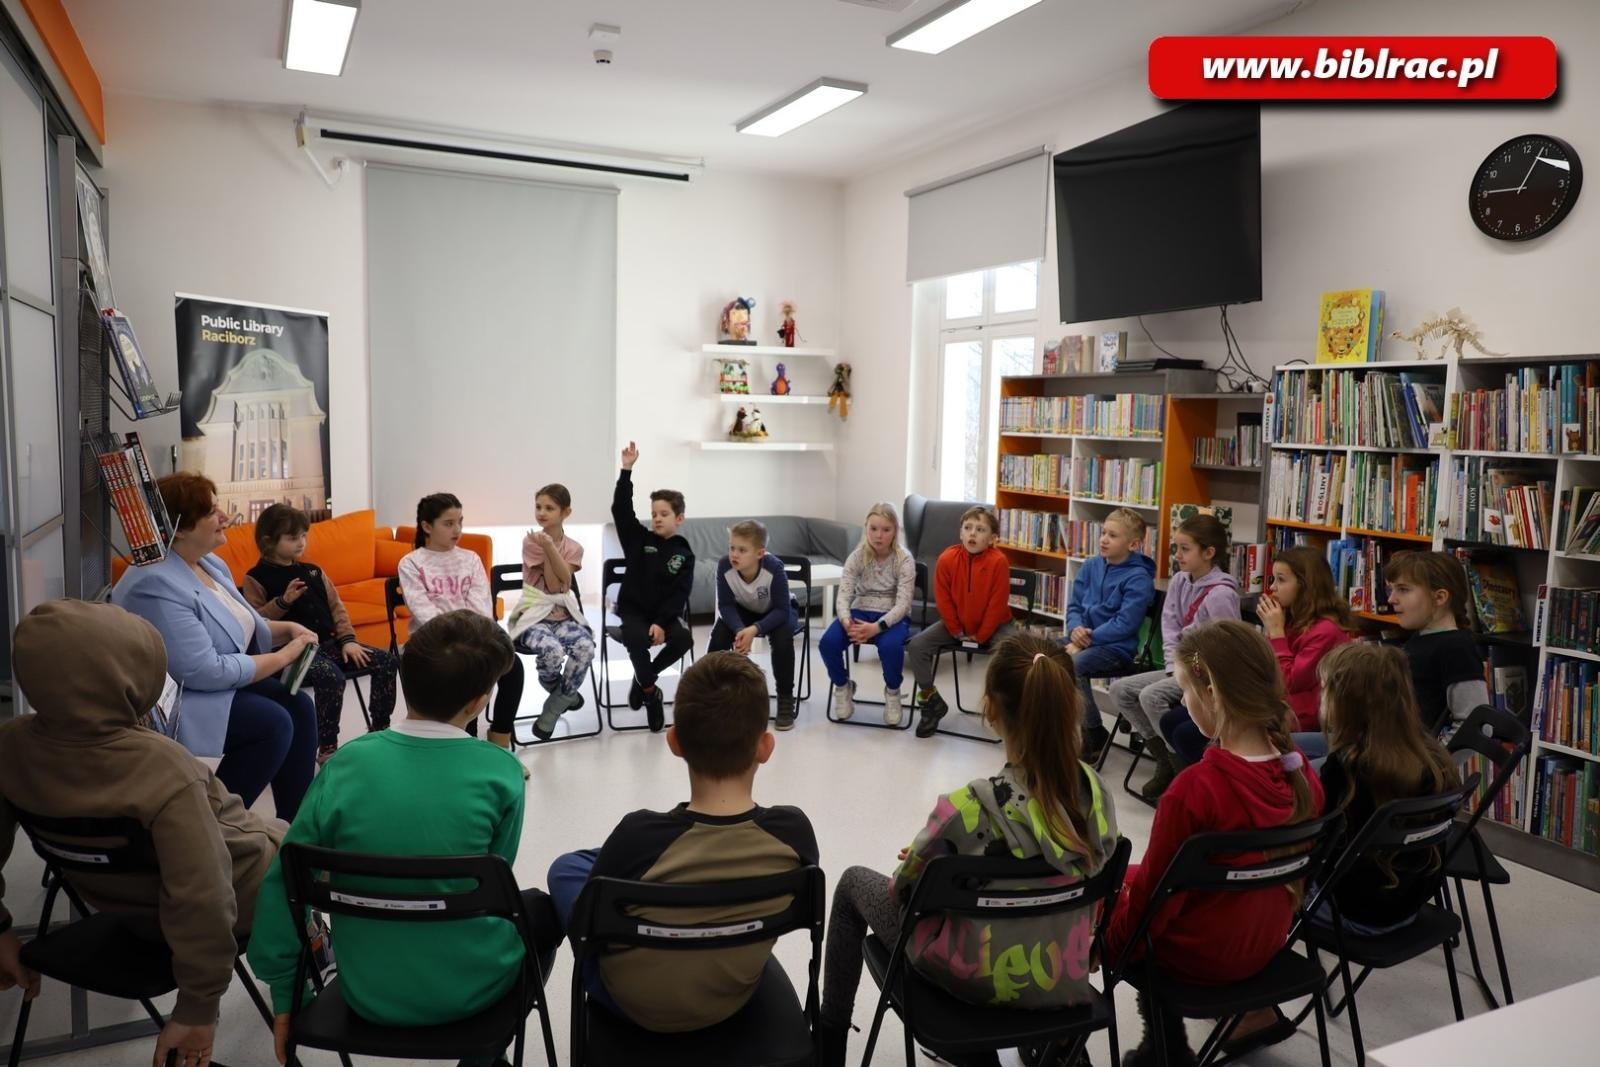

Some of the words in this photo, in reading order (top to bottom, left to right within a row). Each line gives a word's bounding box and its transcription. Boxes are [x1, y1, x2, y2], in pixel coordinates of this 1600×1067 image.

[1523, 145, 1532, 154] 12
[1504, 155, 1512, 163] 11
[1490, 170, 1498, 178] 10
[1559, 180, 1565, 188] 3
[1482, 191, 1488, 199] 9
[1552, 198, 1557, 206] 4
[1485, 207, 1491, 215] 8
[1535, 214, 1541, 223] 5
[1497, 220, 1503, 228] 7
[1514, 223, 1521, 232] 6
[201, 314, 240, 330] Public
[243, 319, 284, 338] Library
[202, 329, 257, 346] Raciborz
